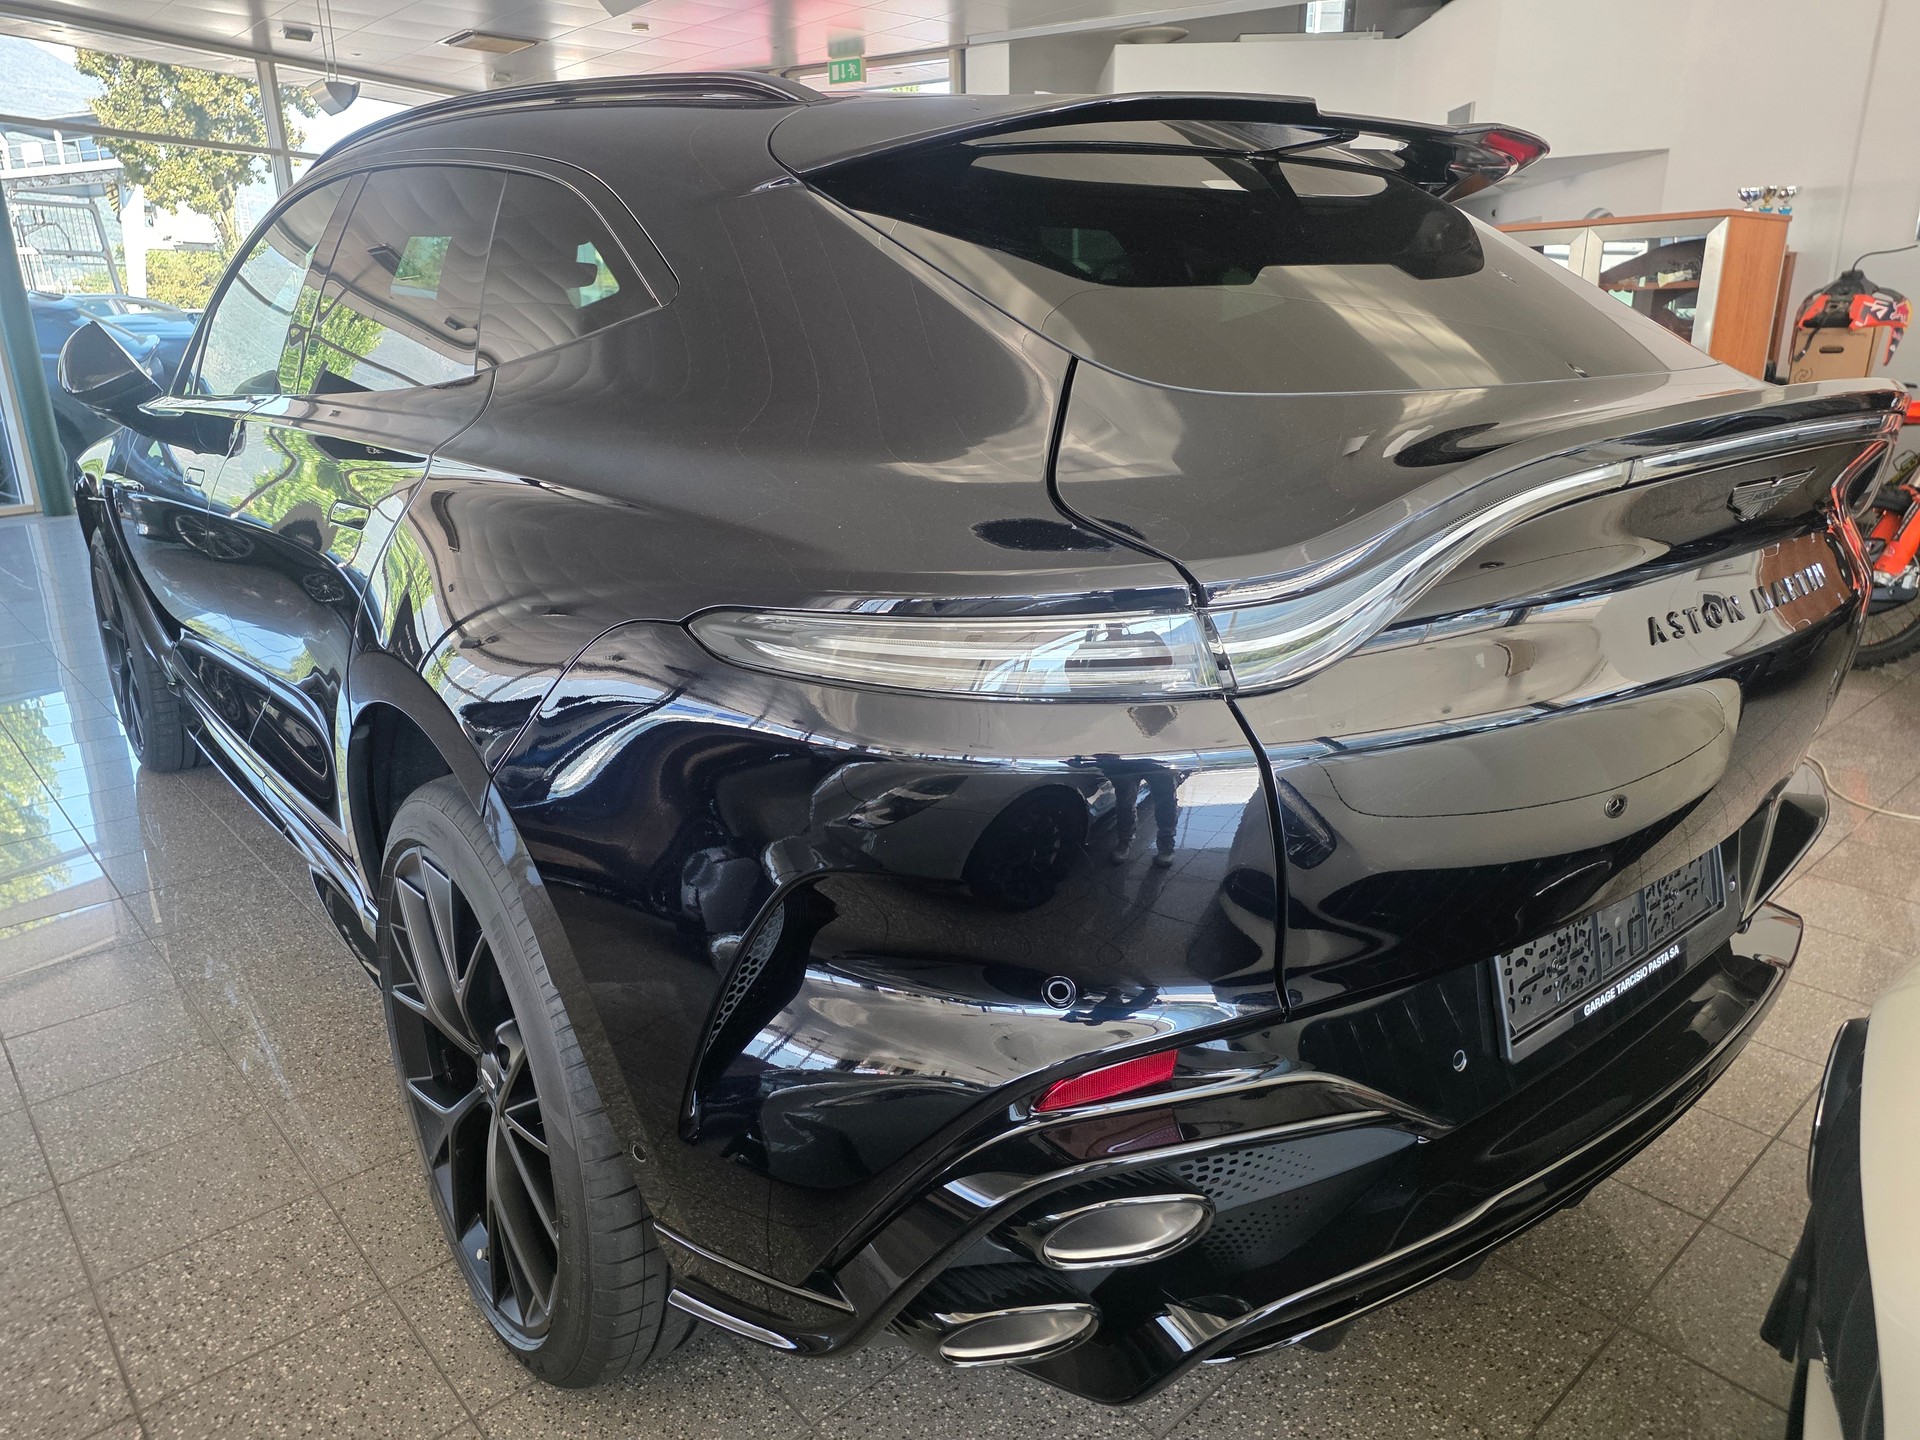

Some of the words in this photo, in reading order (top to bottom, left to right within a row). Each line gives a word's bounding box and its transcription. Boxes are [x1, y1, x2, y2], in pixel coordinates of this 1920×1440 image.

[1647, 594, 1746, 646] ASTON
[1750, 562, 1827, 614] MARTIN
[1583, 987, 1616, 1016] GARAGE
[1615, 966, 1648, 995] TARCISIO
[1648, 951, 1670, 974] PASTA
[1669, 944, 1680, 959] SA
